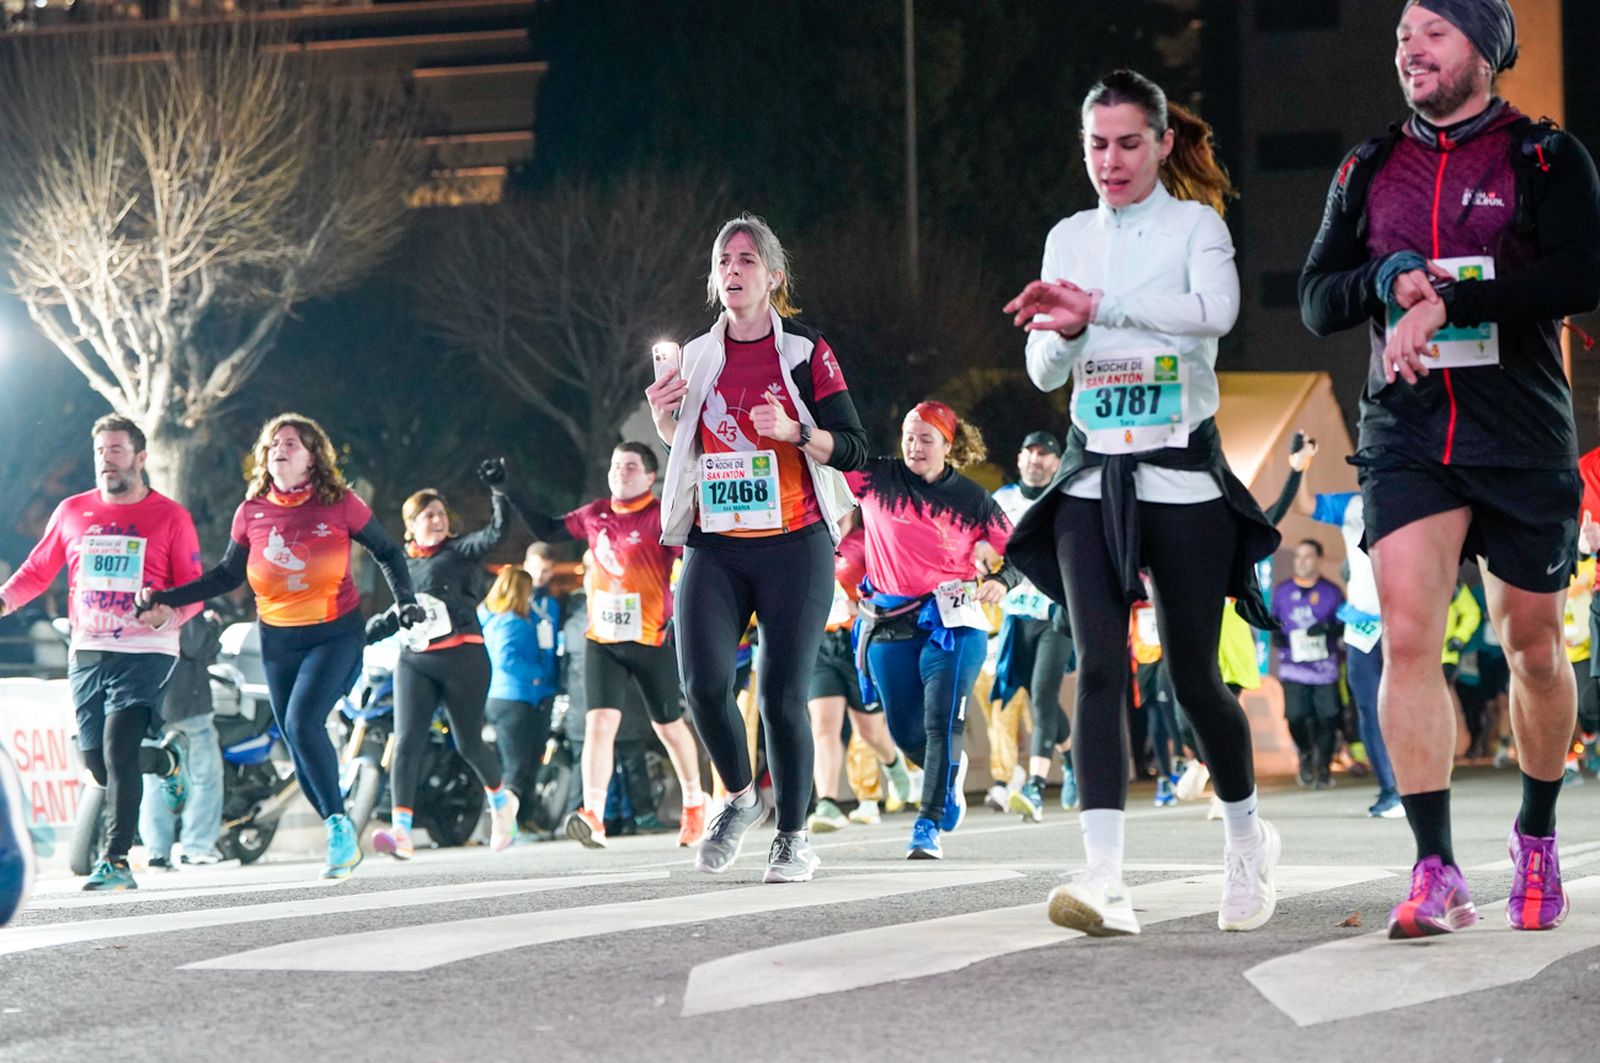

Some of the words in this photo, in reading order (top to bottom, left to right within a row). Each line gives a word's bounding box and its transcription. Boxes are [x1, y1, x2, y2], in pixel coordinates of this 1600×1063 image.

[1097, 363, 1128, 373] NOCHE
[1130, 361, 1143, 371] DE
[1086, 375, 1105, 388] SAN
[1095, 385, 1162, 418] 3787
[717, 421, 737, 442] 43
[715, 461, 733, 469] NOCHE
[735, 460, 744, 468] DE
[707, 472, 720, 480] SAN
[709, 479, 768, 504] 12468
[94, 555, 130, 572] 8077
[13, 729, 67, 772] SAN
